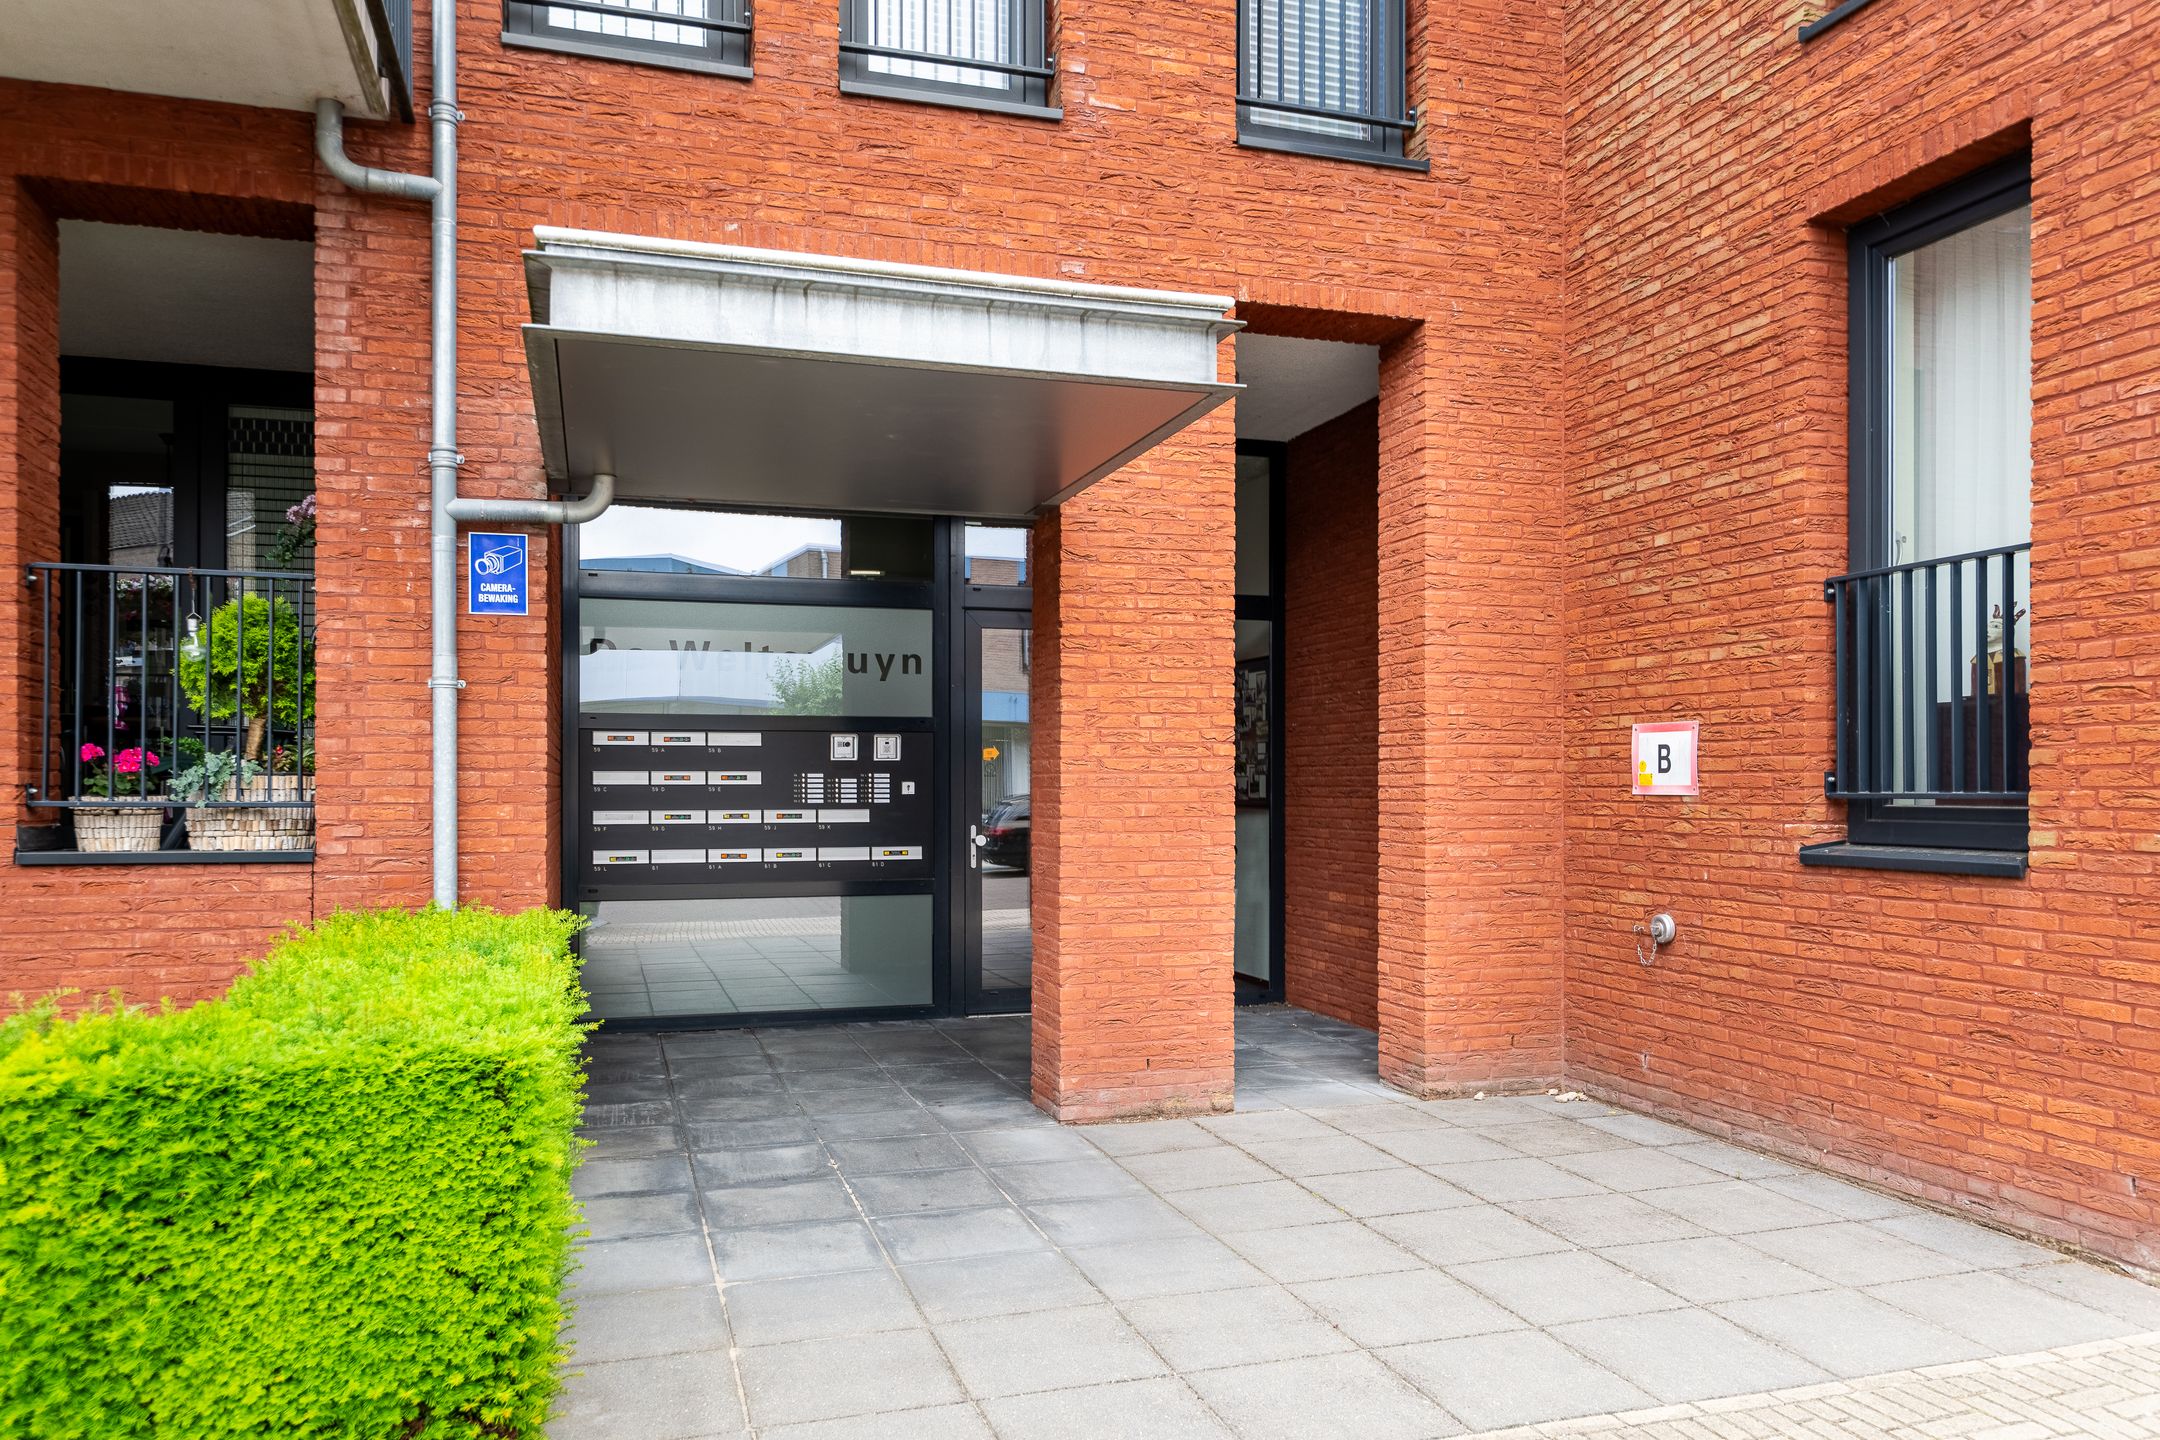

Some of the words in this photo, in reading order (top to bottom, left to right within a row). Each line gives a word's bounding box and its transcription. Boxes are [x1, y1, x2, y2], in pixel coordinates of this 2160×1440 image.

[480, 583, 516, 593] CAMERA-
[478, 594, 519, 604] BEWAKING
[1658, 744, 1672, 774] B
